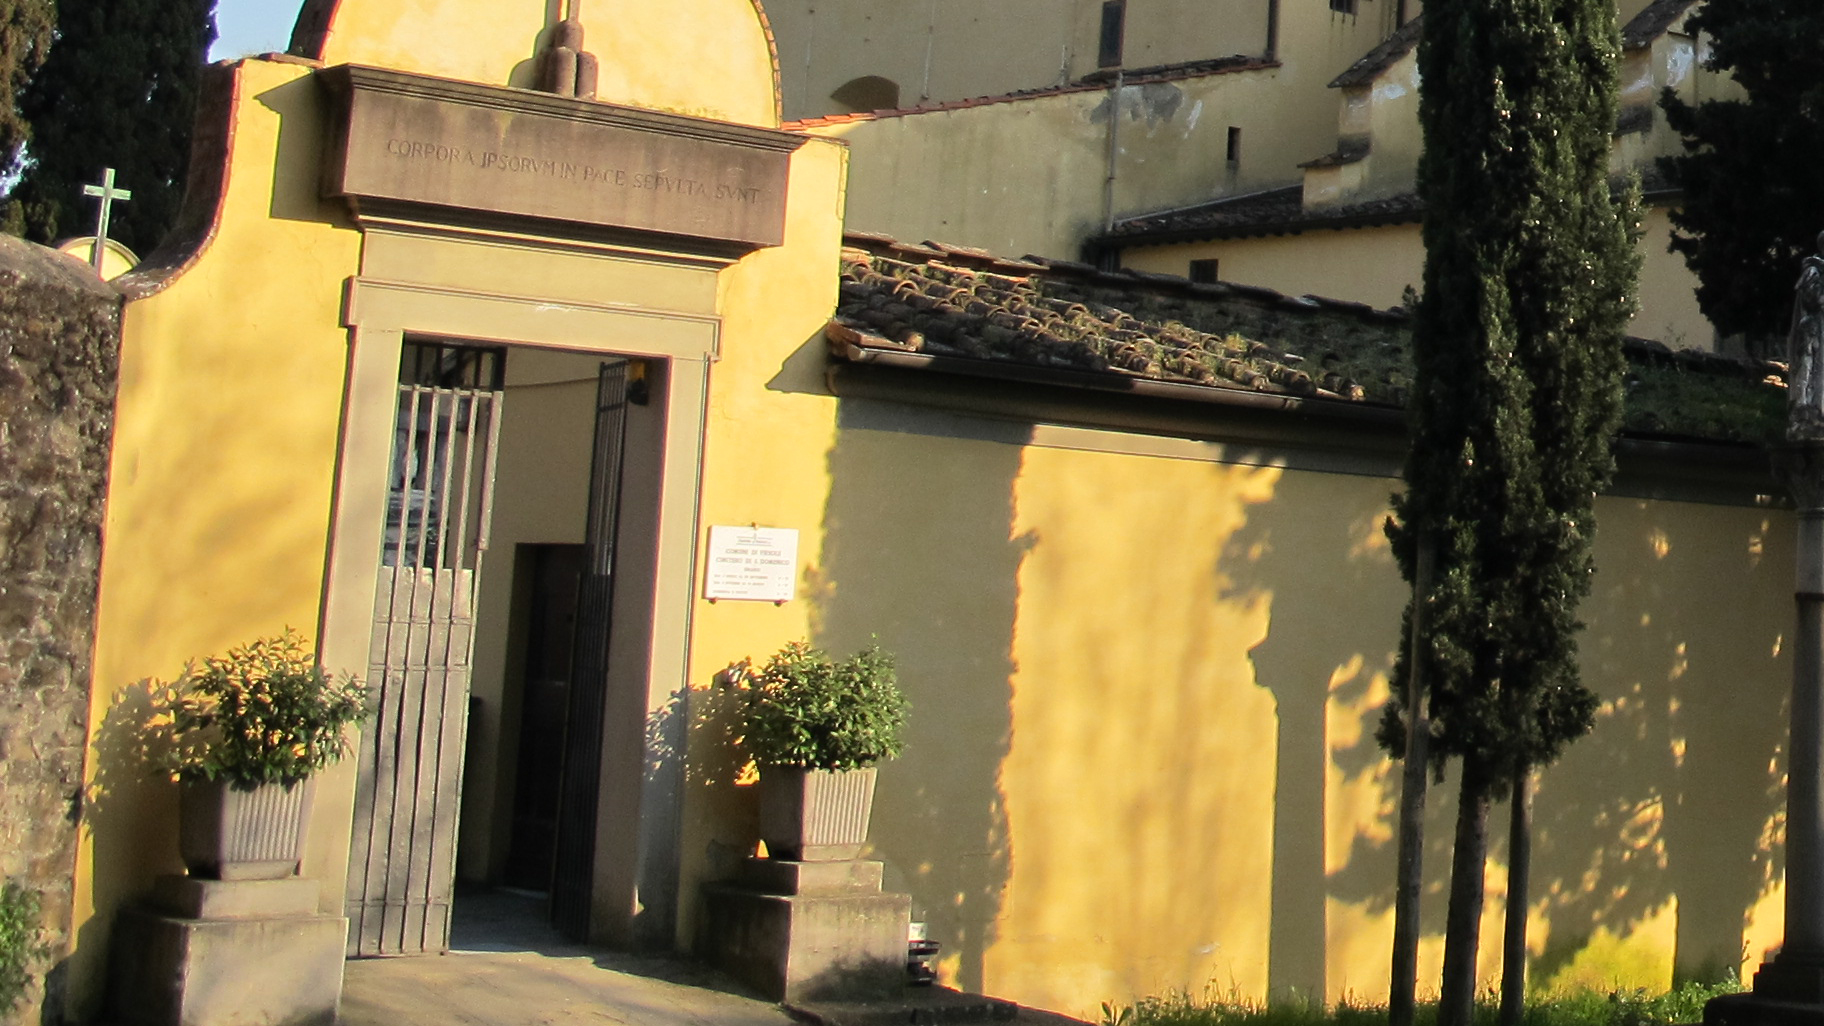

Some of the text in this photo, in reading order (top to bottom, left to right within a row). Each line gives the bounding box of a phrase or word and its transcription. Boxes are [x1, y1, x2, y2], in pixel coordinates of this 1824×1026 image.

[387, 139, 475, 165] CORPORA
[560, 162, 577, 179] IN
[583, 165, 625, 185] PACE
[633, 171, 706, 196] SEPVLTA
[715, 183, 760, 204] SVNT
